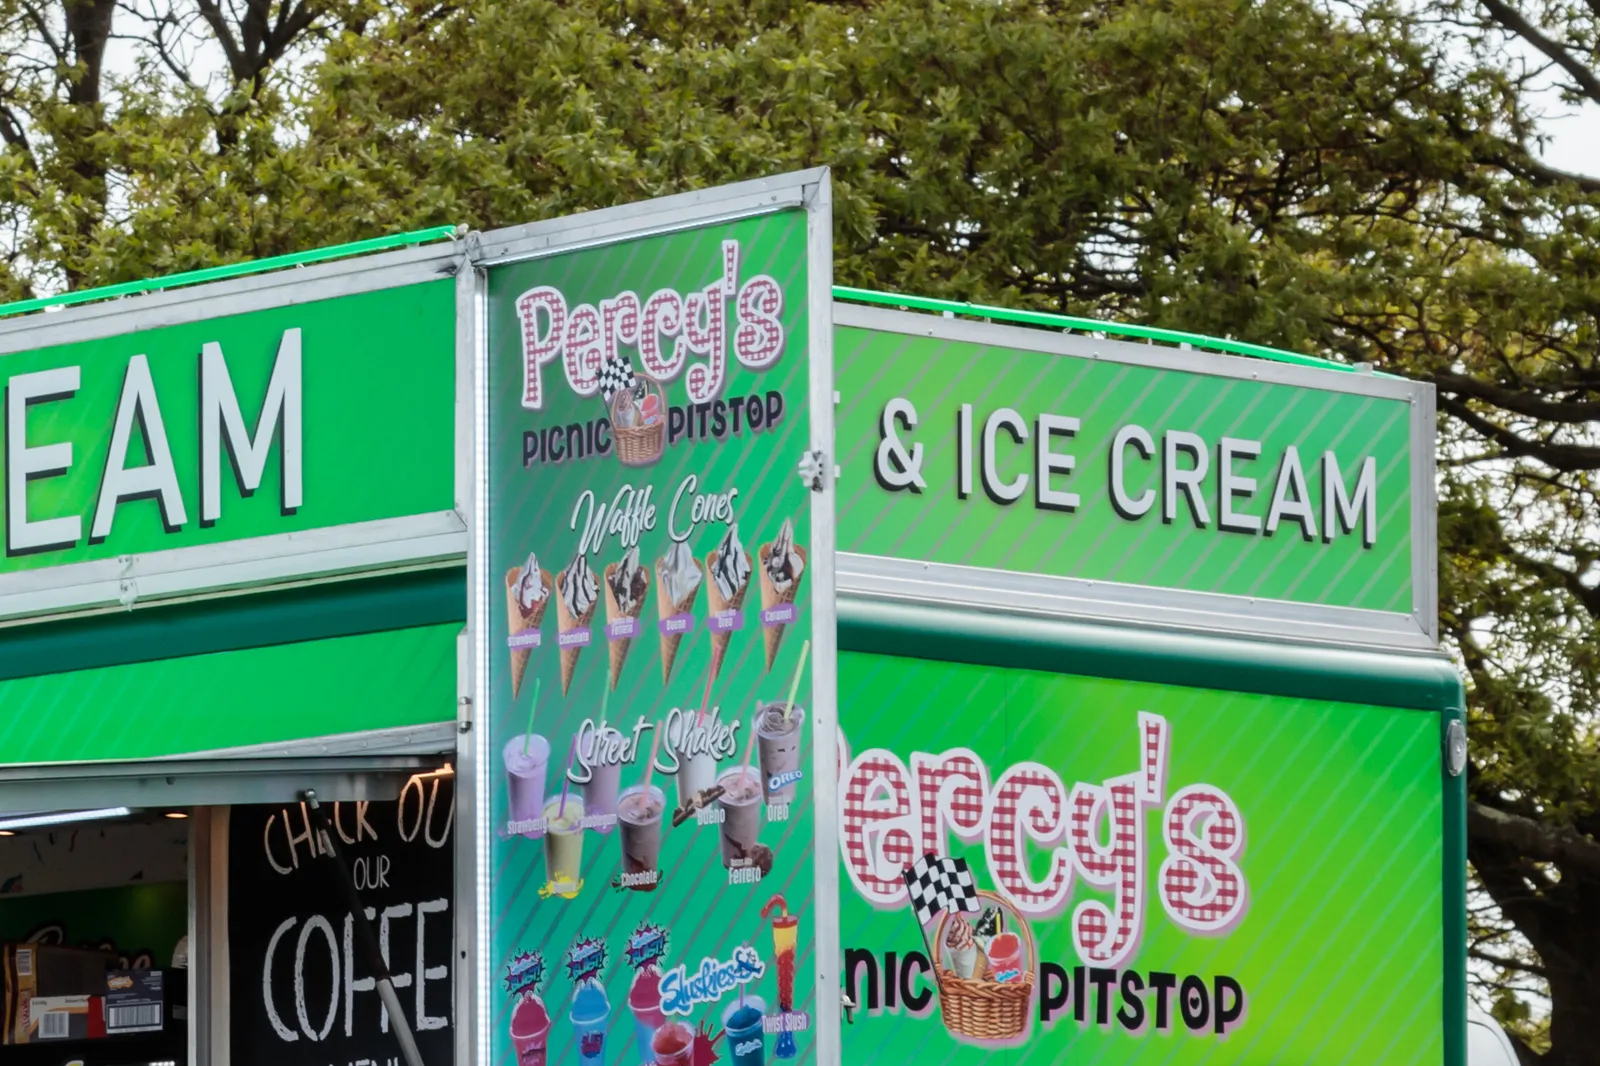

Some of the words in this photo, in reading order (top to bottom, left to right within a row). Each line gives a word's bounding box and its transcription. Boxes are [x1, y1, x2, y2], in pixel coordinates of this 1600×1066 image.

[516, 239, 785, 410] Percy's
[522, 418, 614, 467] PICNIC
[668, 390, 784, 444] PITSTOP
[874, 398, 927, 494] &
[958, 404, 1080, 514] ICE
[1108, 424, 1376, 549] CREAM
[570, 483, 657, 555] Waffle
[668, 474, 738, 542] Cones
[567, 716, 653, 783] Street
[654, 706, 739, 773] Shakes
[769, 770, 802, 790] OREO
[768, 804, 788, 821] Oreo
[838, 711, 1246, 969] ercy's
[354, 855, 390, 891] OUR
[621, 870, 657, 886] Chocolate
[729, 868, 761, 884] Ferrero
[262, 897, 455, 1041] COFFE
[844, 947, 933, 1011] NIC
[1040, 962, 1244, 1034] PITSTOP
[762, 1015, 784, 1033] Twist
[786, 1013, 806, 1031] Slush
